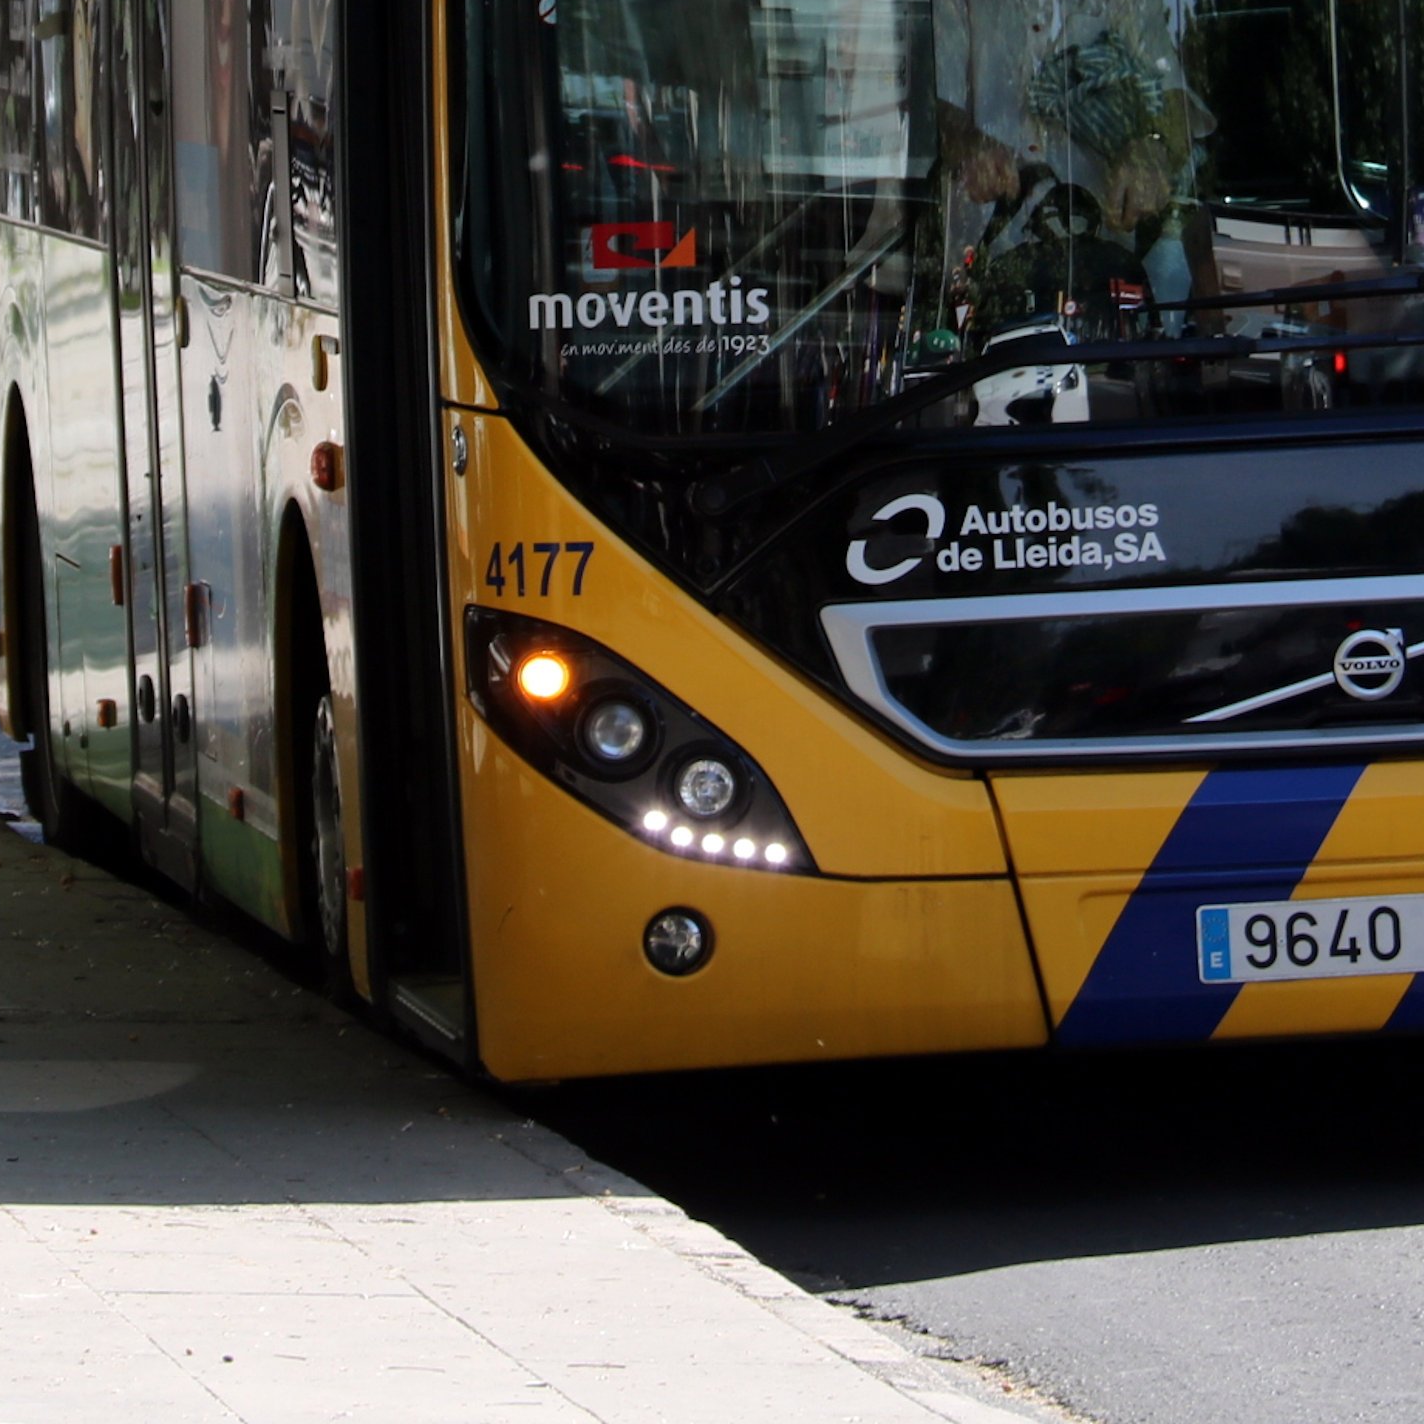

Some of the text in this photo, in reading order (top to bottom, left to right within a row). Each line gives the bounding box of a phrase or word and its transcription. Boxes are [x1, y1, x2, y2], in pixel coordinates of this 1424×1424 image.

[528, 275, 770, 332] moventis
[721, 334, 771, 356] 1923
[959, 502, 1159, 537] Autobusos
[485, 540, 595, 599] 4177
[936, 541, 983, 572] de
[1338, 659, 1401, 672] VOLVO
[1243, 906, 1402, 970] 9640
[1209, 950, 1223, 968] E
